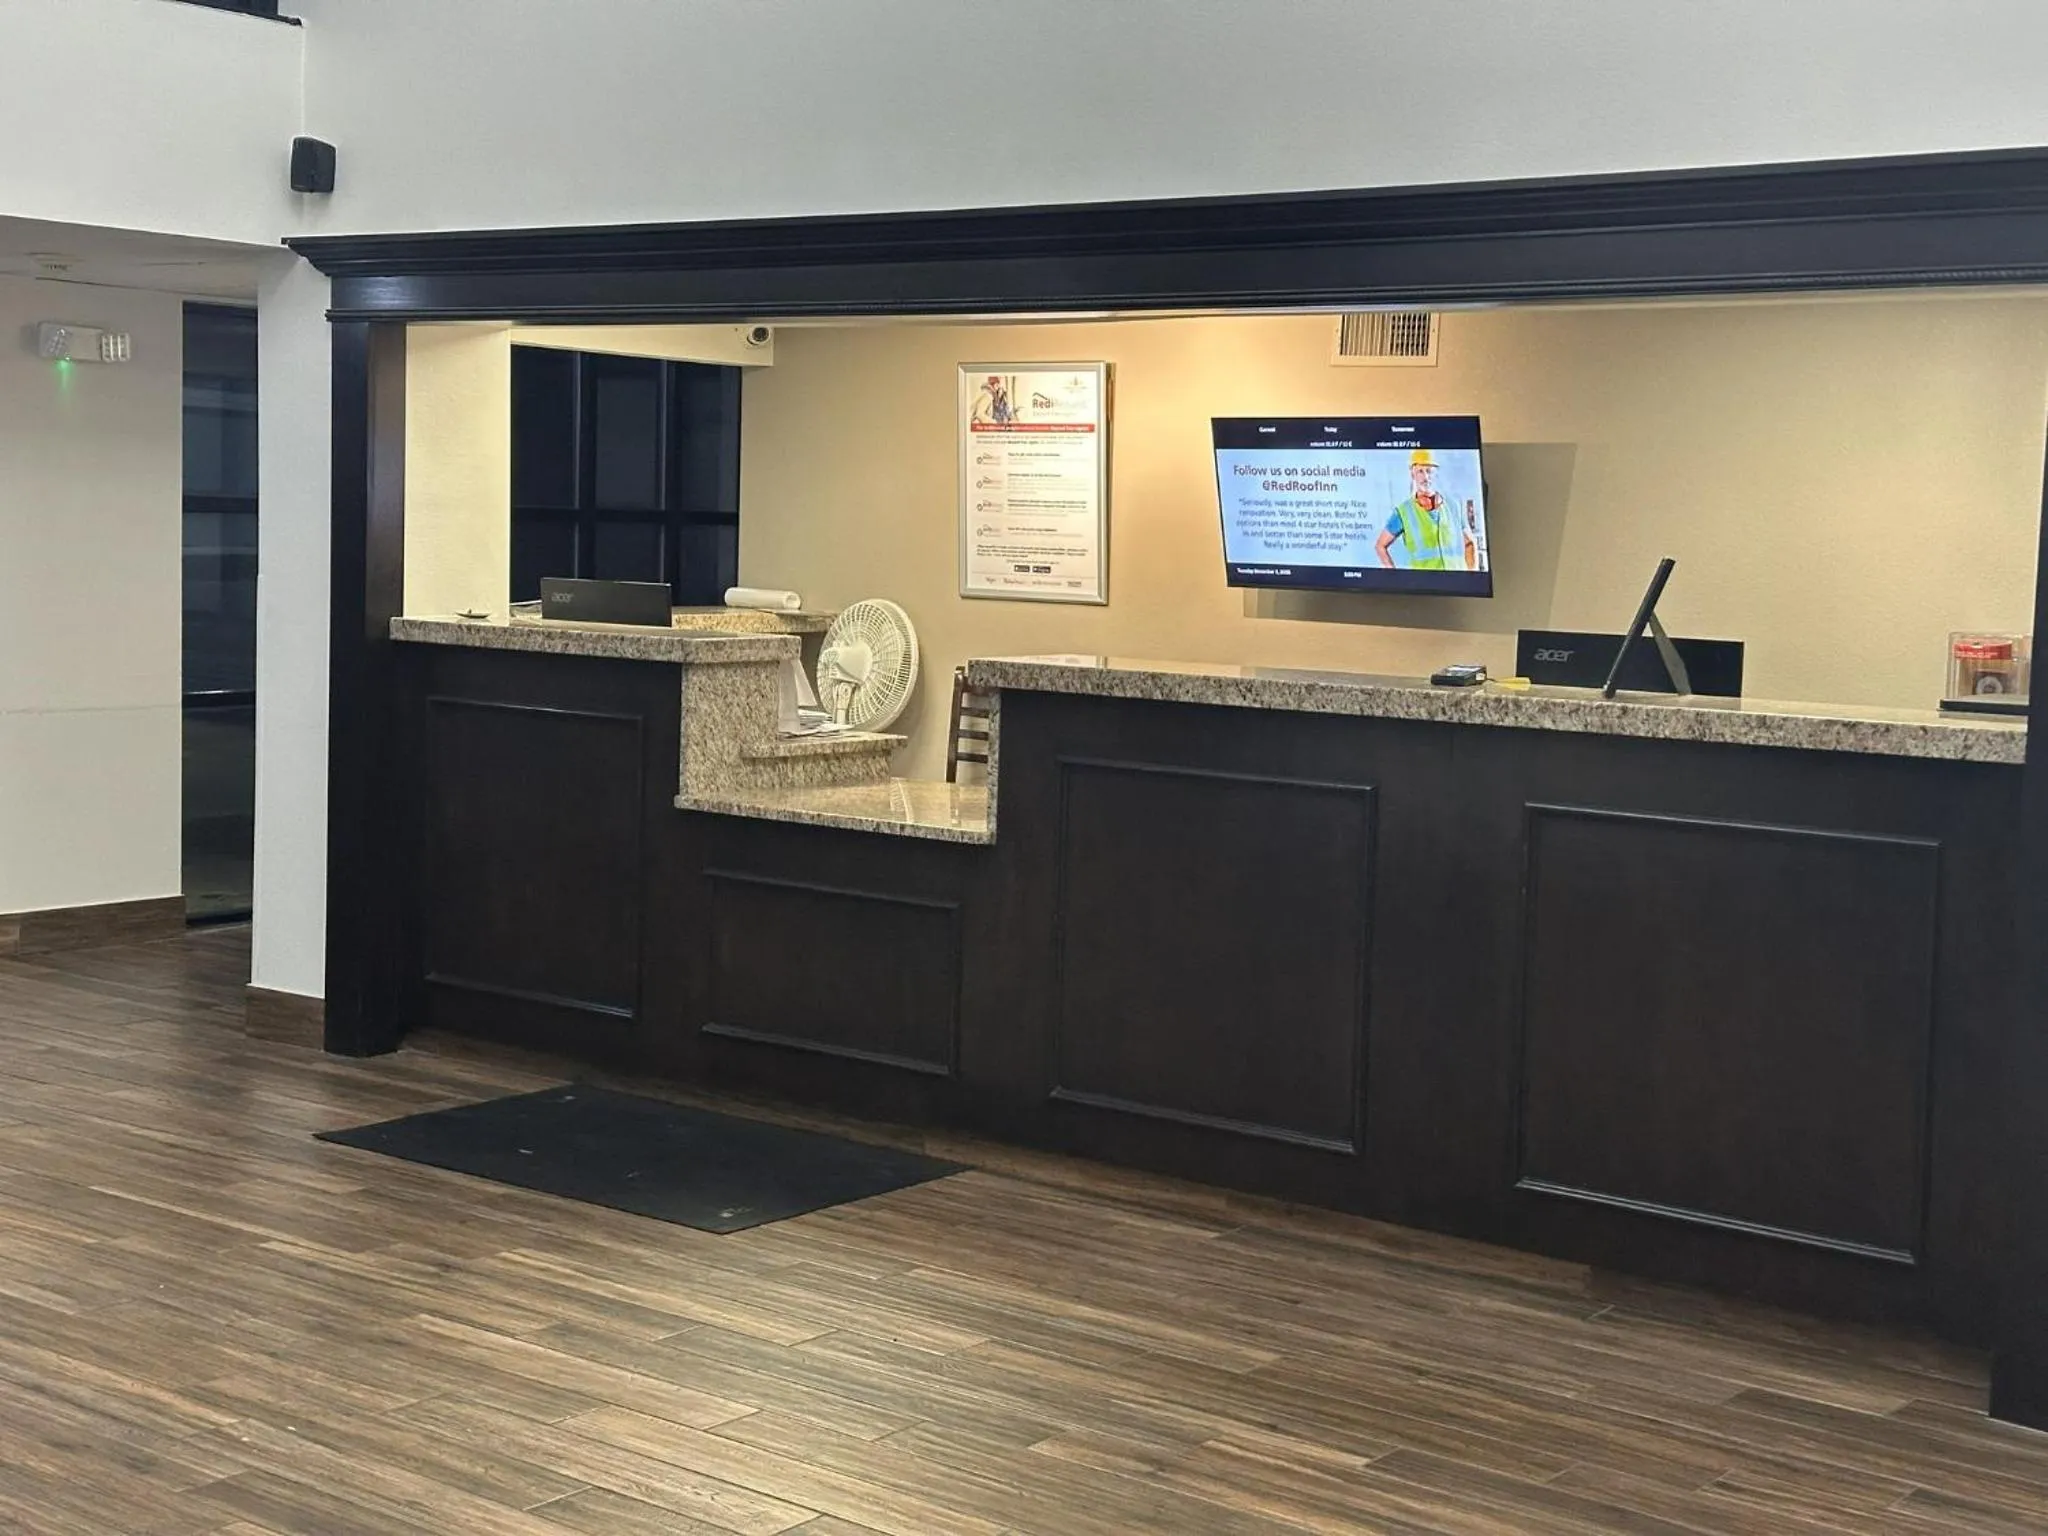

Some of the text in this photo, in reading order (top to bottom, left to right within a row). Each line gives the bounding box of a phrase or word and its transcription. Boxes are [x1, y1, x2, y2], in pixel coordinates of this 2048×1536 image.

[1233, 465, 1366, 477] Follow us on social media
[1262, 480, 1338, 492] @RedRoofInn
[1295, 500, 1314, 509] great
[1315, 500, 1332, 508] short
[1297, 511, 1311, 519] very
[1263, 520, 1279, 528] than
[1303, 521, 1317, 529] star
[1318, 521, 1339, 529] hotels
[1354, 522, 1373, 530] been
[1265, 530, 1286, 538] better
[551, 593, 575, 603] acer
[1534, 648, 1575, 662] acer
